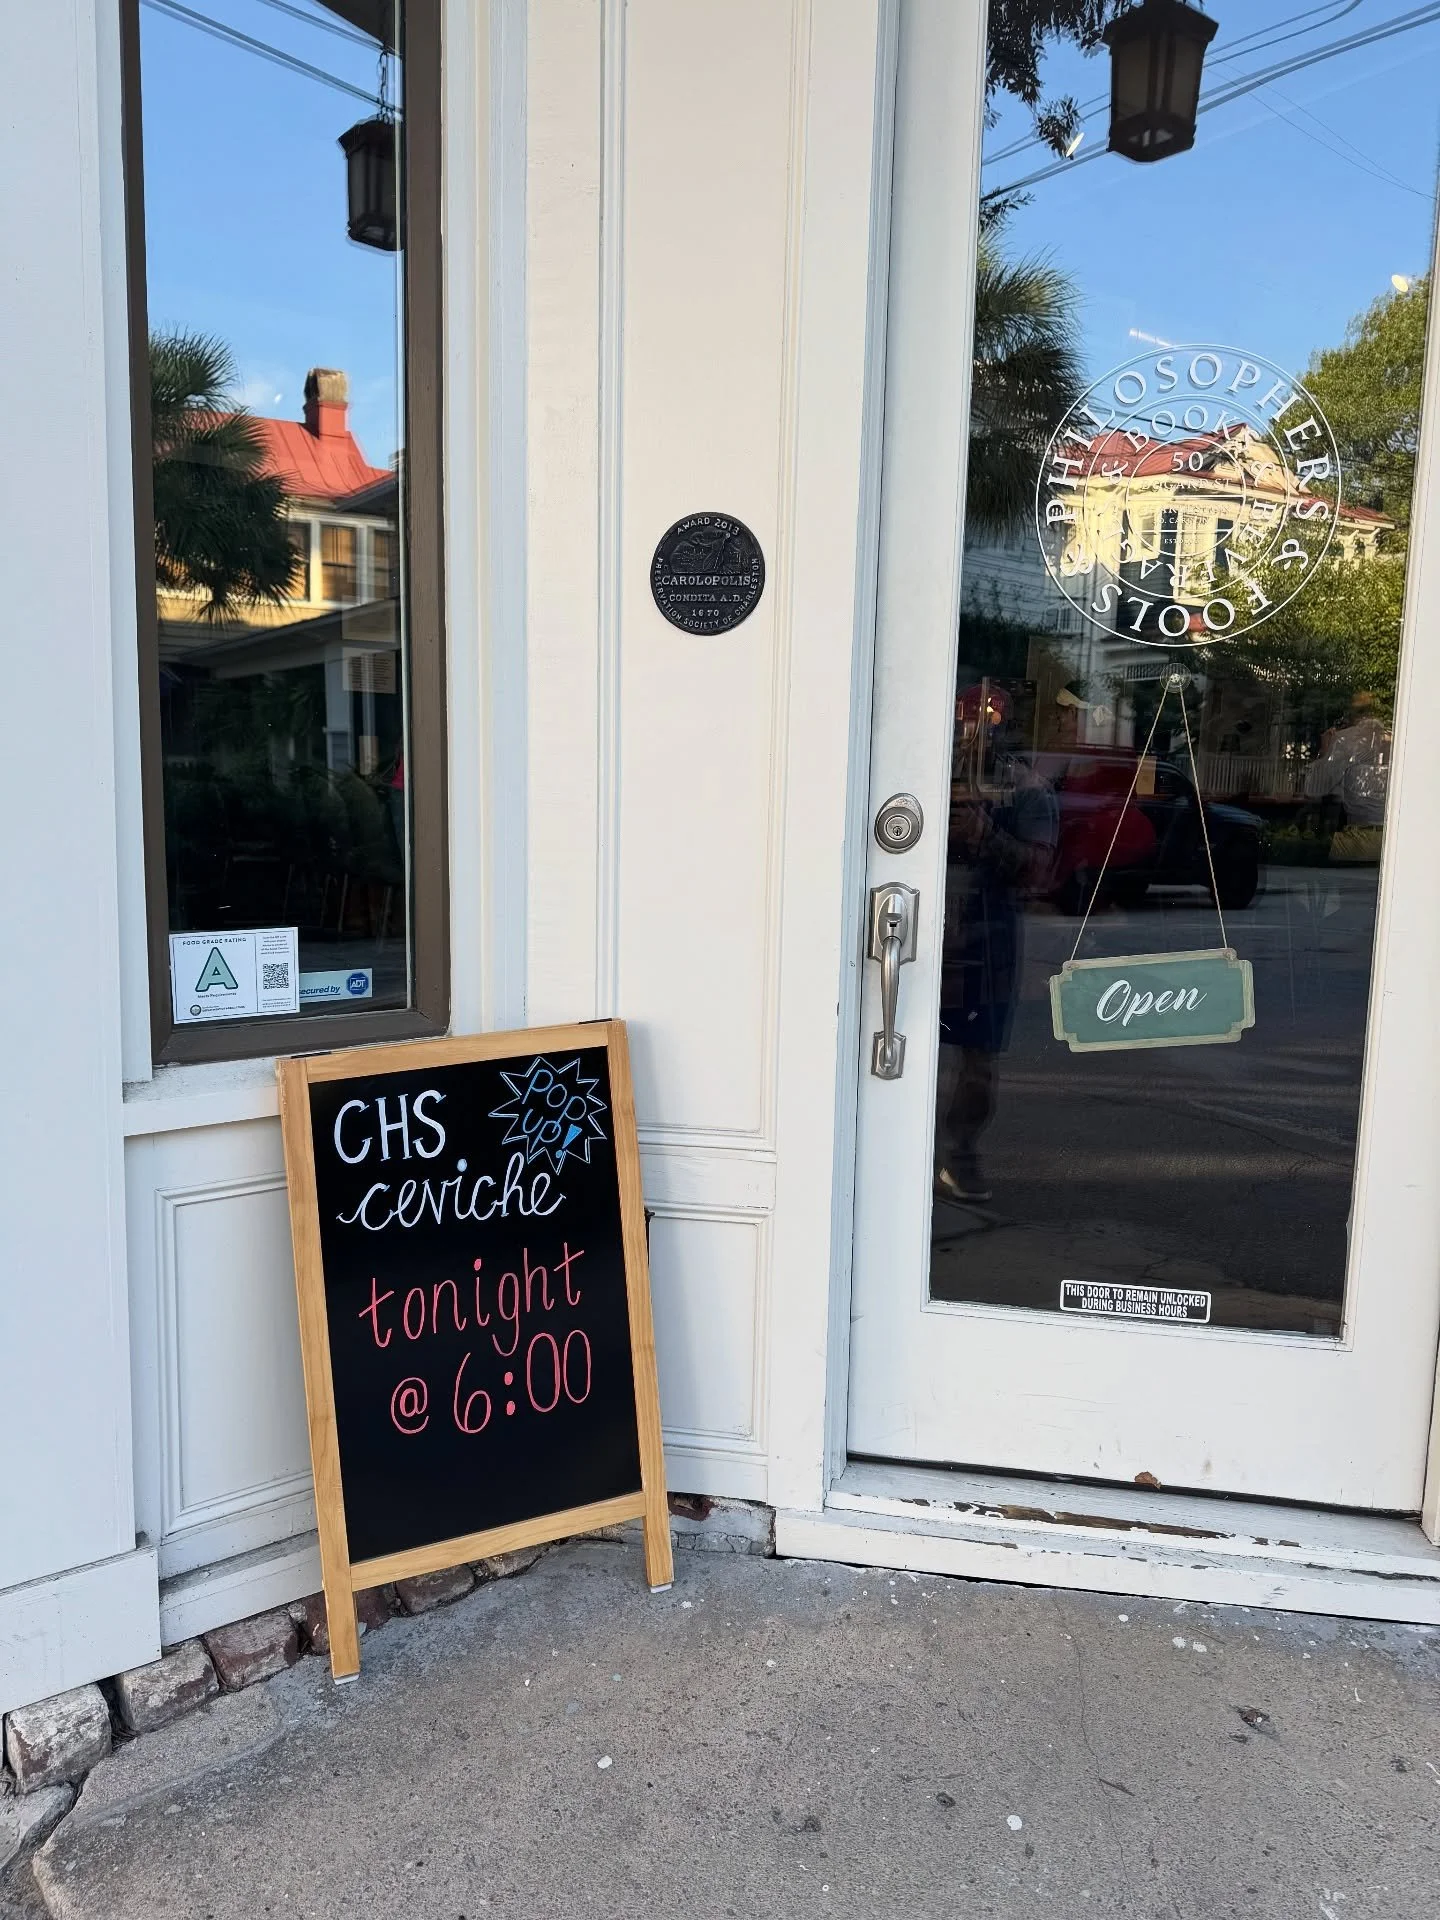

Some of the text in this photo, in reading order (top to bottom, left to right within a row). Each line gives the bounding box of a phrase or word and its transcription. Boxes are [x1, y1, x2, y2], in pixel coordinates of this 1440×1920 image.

[1045, 352, 1330, 526] PHILOSOPHERS
[1172, 451, 1204, 472] 50
[676, 517, 711, 535] AWARD
[1271, 538, 1309, 574] &
[654, 556, 761, 629] PRESERVATION SOCIETY OF CHARLESTON
[661, 575, 751, 586] CAROLOPOLIS
[669, 593, 743, 602] CONDITA A.D.
[692, 609, 720, 617] 1670
[1092, 575, 1273, 637] FOOLS
[195, 946, 239, 992] A
[350, 979, 366, 990] ADT
[329, 985, 341, 996] by
[1096, 979, 1208, 1027] Open
[334, 1089, 447, 1165] CHS
[336, 1151, 567, 1231] ceviche
[358, 1242, 585, 1358] tonight
[1065, 1283, 1206, 1307] THIS DOOR TO REMAIN UNLOCKED
[1081, 1297, 1188, 1318] DURING BUSINESS HOURS
[390, 1329, 593, 1435] @ 6:00
